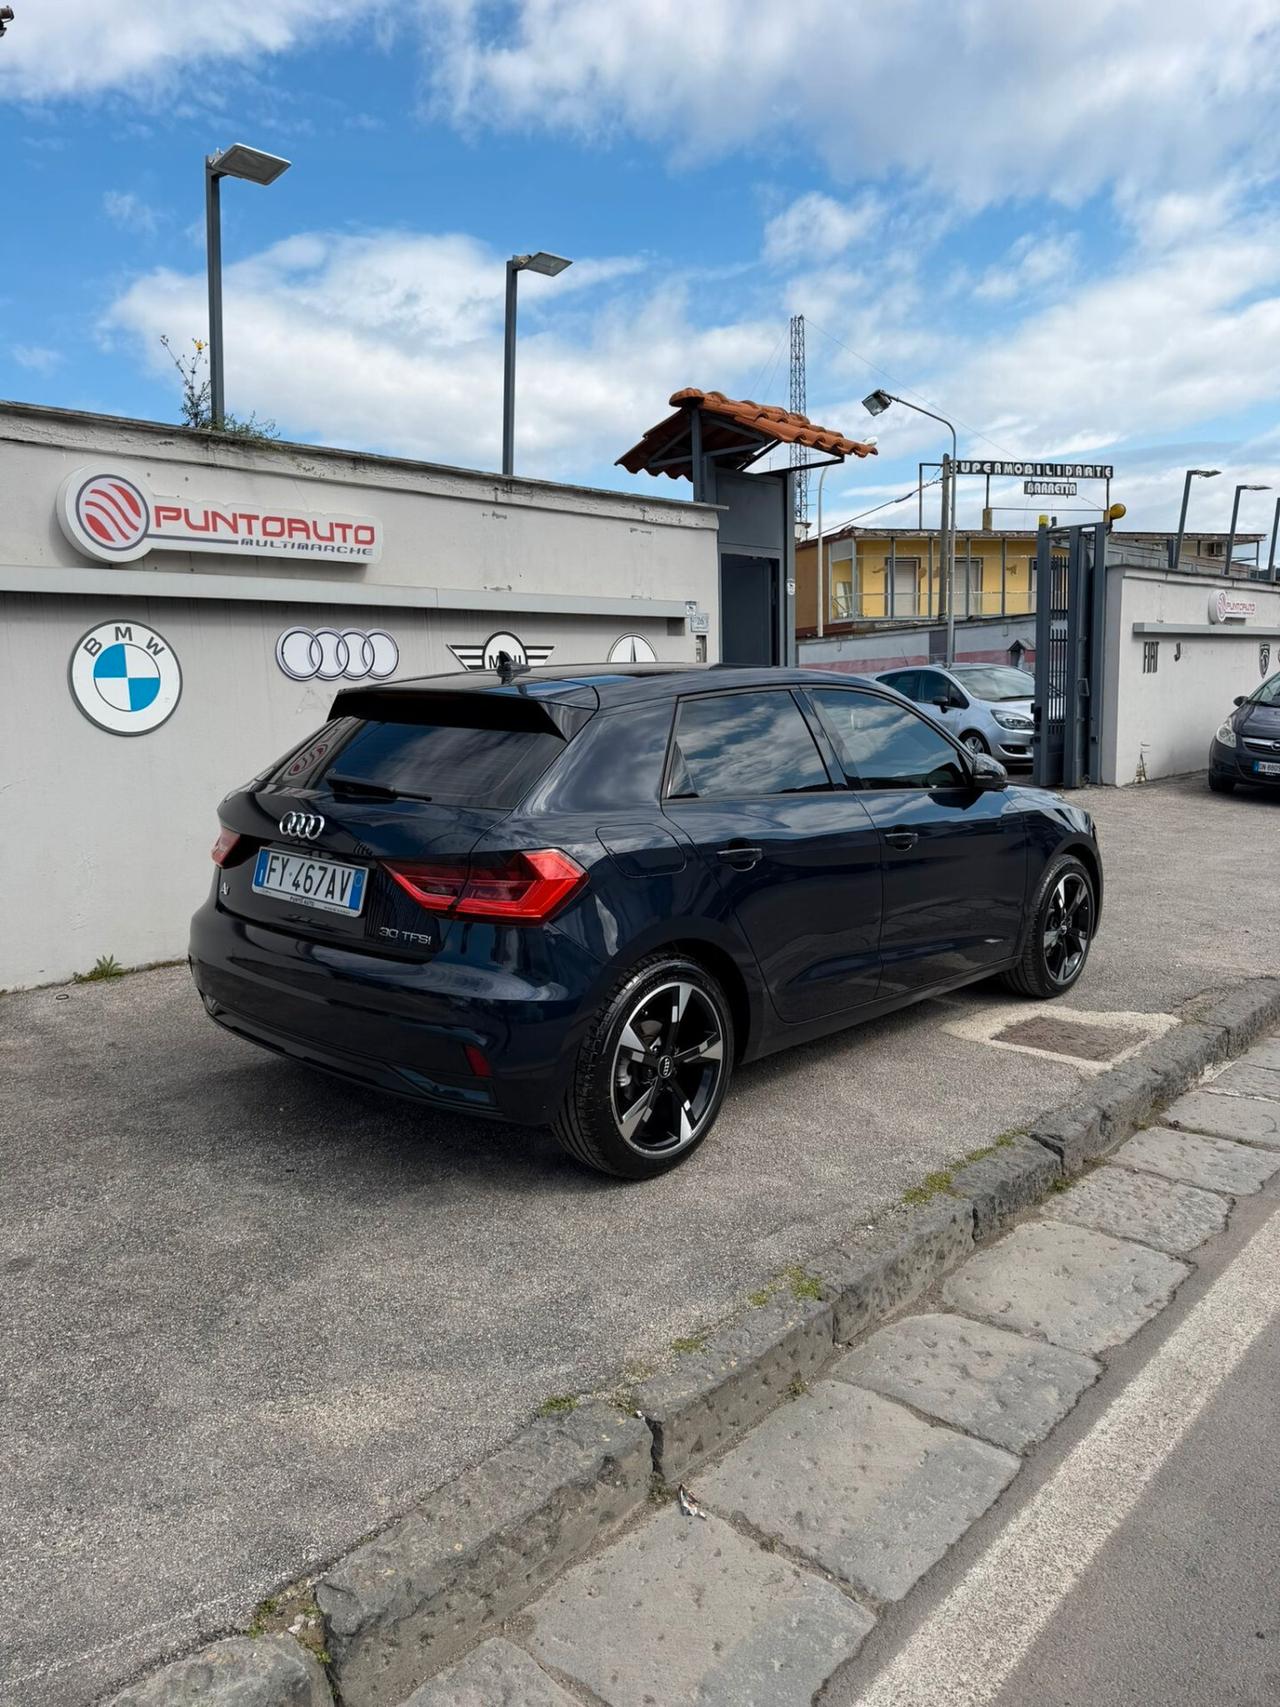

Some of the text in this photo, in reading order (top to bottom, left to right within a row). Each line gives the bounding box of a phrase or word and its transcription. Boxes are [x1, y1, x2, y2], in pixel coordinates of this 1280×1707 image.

[1027, 482, 1076, 494] BARRETTA
[154, 505, 375, 545] PUNTOAUTO
[240, 538, 374, 556] MULTIMARCHE
[83, 625, 165, 657] BMW
[1143, 641, 1159, 673] FIAT
[379, 926, 399, 938] 30
